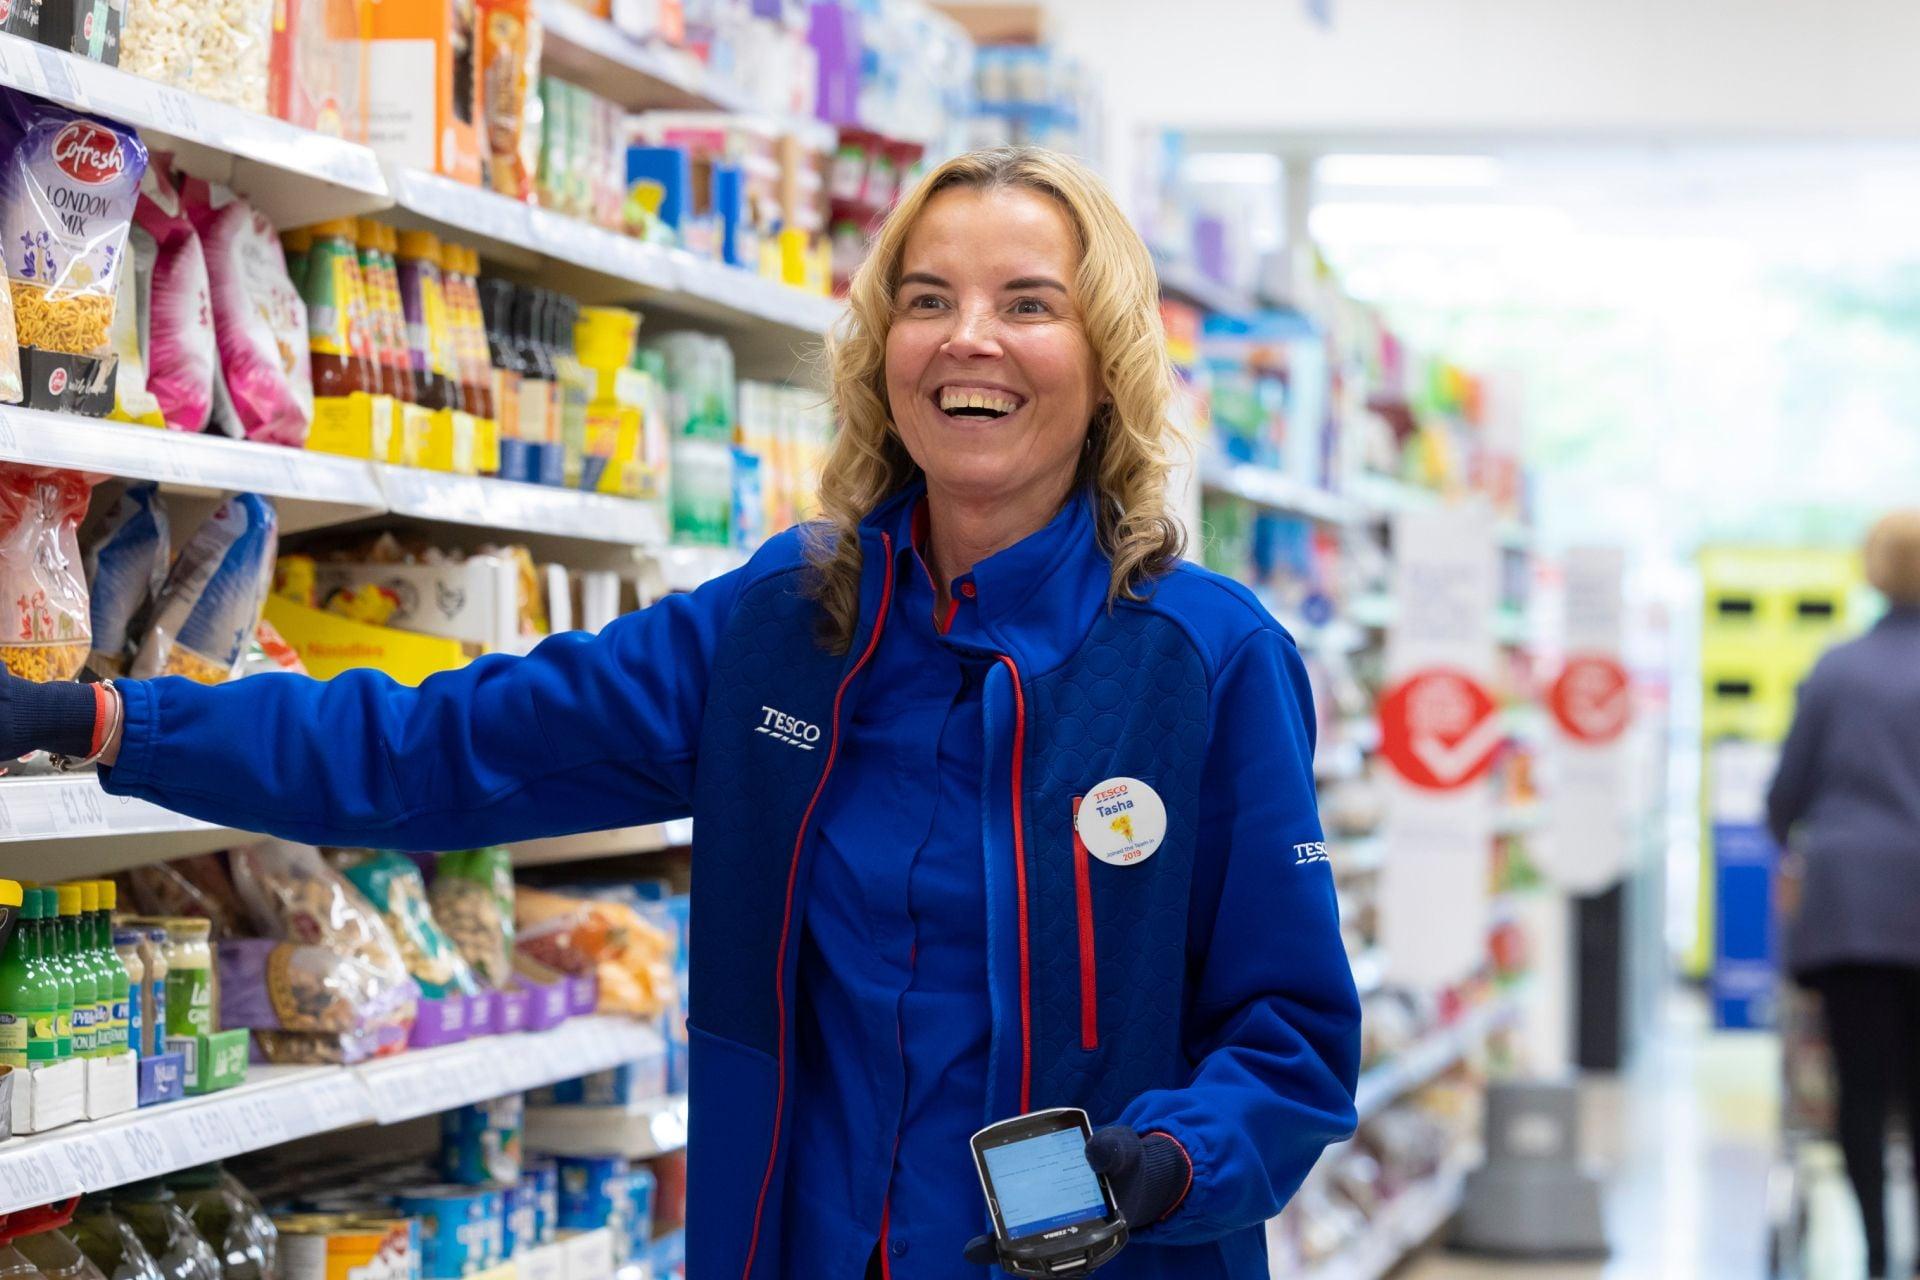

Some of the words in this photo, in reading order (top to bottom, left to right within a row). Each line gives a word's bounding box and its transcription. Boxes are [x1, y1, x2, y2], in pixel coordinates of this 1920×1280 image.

[54, 126, 125, 173] Cofresh
[48, 186, 111, 218] LONDON
[61, 212, 88, 237] MIX
[761, 705, 821, 742] TESCO
[1093, 784, 1128, 802] TESCO
[1096, 799, 1134, 818] Tasha
[1122, 849, 1142, 861] 2019
[64, 1141, 105, 1188] 95p
[124, 1126, 164, 1173] 80p
